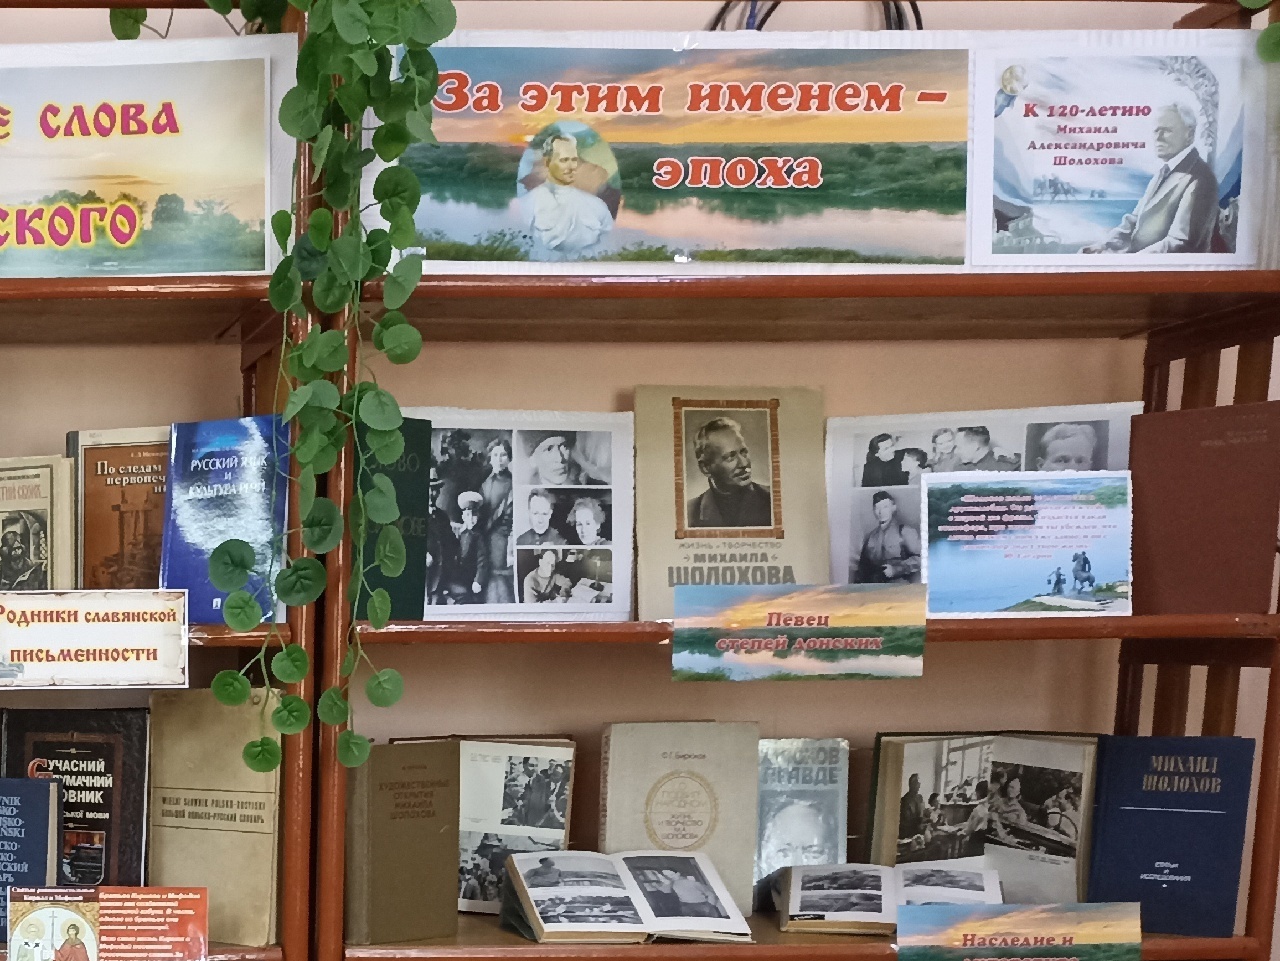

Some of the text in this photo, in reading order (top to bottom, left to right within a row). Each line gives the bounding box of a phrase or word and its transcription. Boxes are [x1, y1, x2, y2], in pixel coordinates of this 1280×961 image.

[433, 71, 906, 114] За этим именем
[1023, 103, 1152, 118] К 120-летию
[1056, 124, 1118, 134] Михаила
[1027, 140, 1146, 151] Александровича
[1053, 156, 1124, 166] Шолохова
[653, 156, 824, 189] эпоха
[96, 461, 162, 475] По следам
[191, 456, 238, 471] РУССКИЙ
[188, 484, 237, 499] КУЛЬТУРА
[693, 553, 769, 565] МИХАИЛА
[667, 565, 796, 588] ШОЛОХОВА
[84, 608, 177, 624] славянской
[766, 611, 830, 628] Певец
[715, 634, 883, 652] степей донских
[9, 645, 158, 663] письменности
[1151, 755, 1218, 773] МИХАИЛ
[1142, 774, 1222, 793] ШОЛОХОВ
[961, 932, 1074, 948] Наследие и
